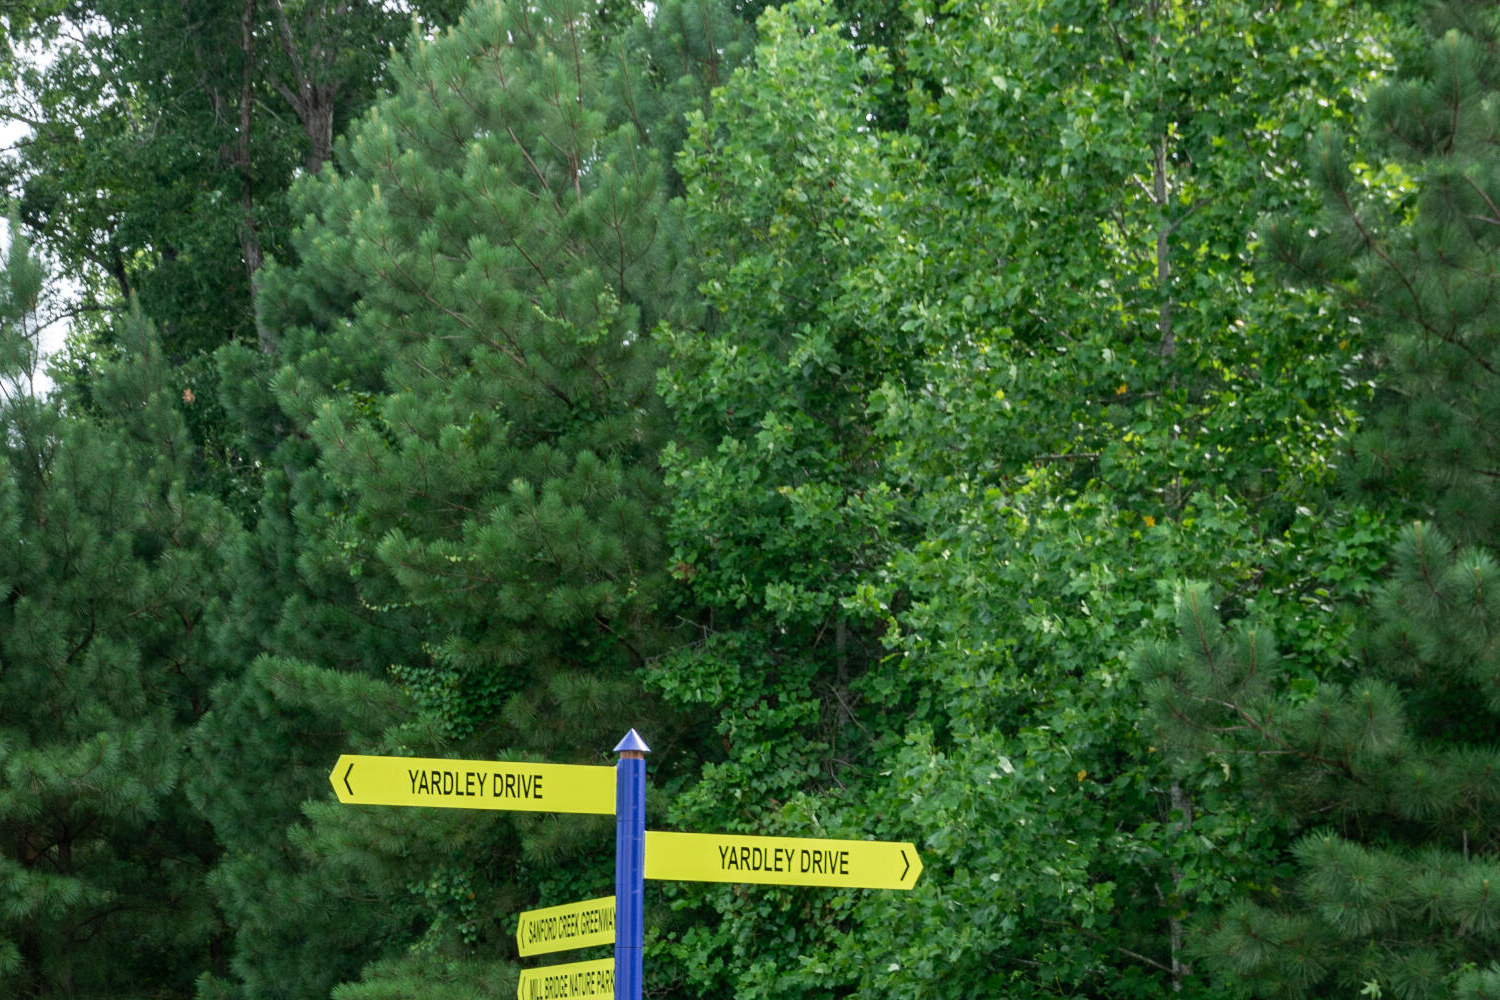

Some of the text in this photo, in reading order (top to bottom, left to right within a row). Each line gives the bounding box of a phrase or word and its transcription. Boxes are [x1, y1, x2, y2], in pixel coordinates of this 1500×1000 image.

[408, 769, 543, 799] YARDLEY DRIVE
[718, 845, 849, 875] YARDLEY DRIVE
[529, 918, 557, 943] SANFORD
[559, 913, 579, 938] CREEK
[530, 969, 615, 1000] MILL BRIDGE NATURE PARK
